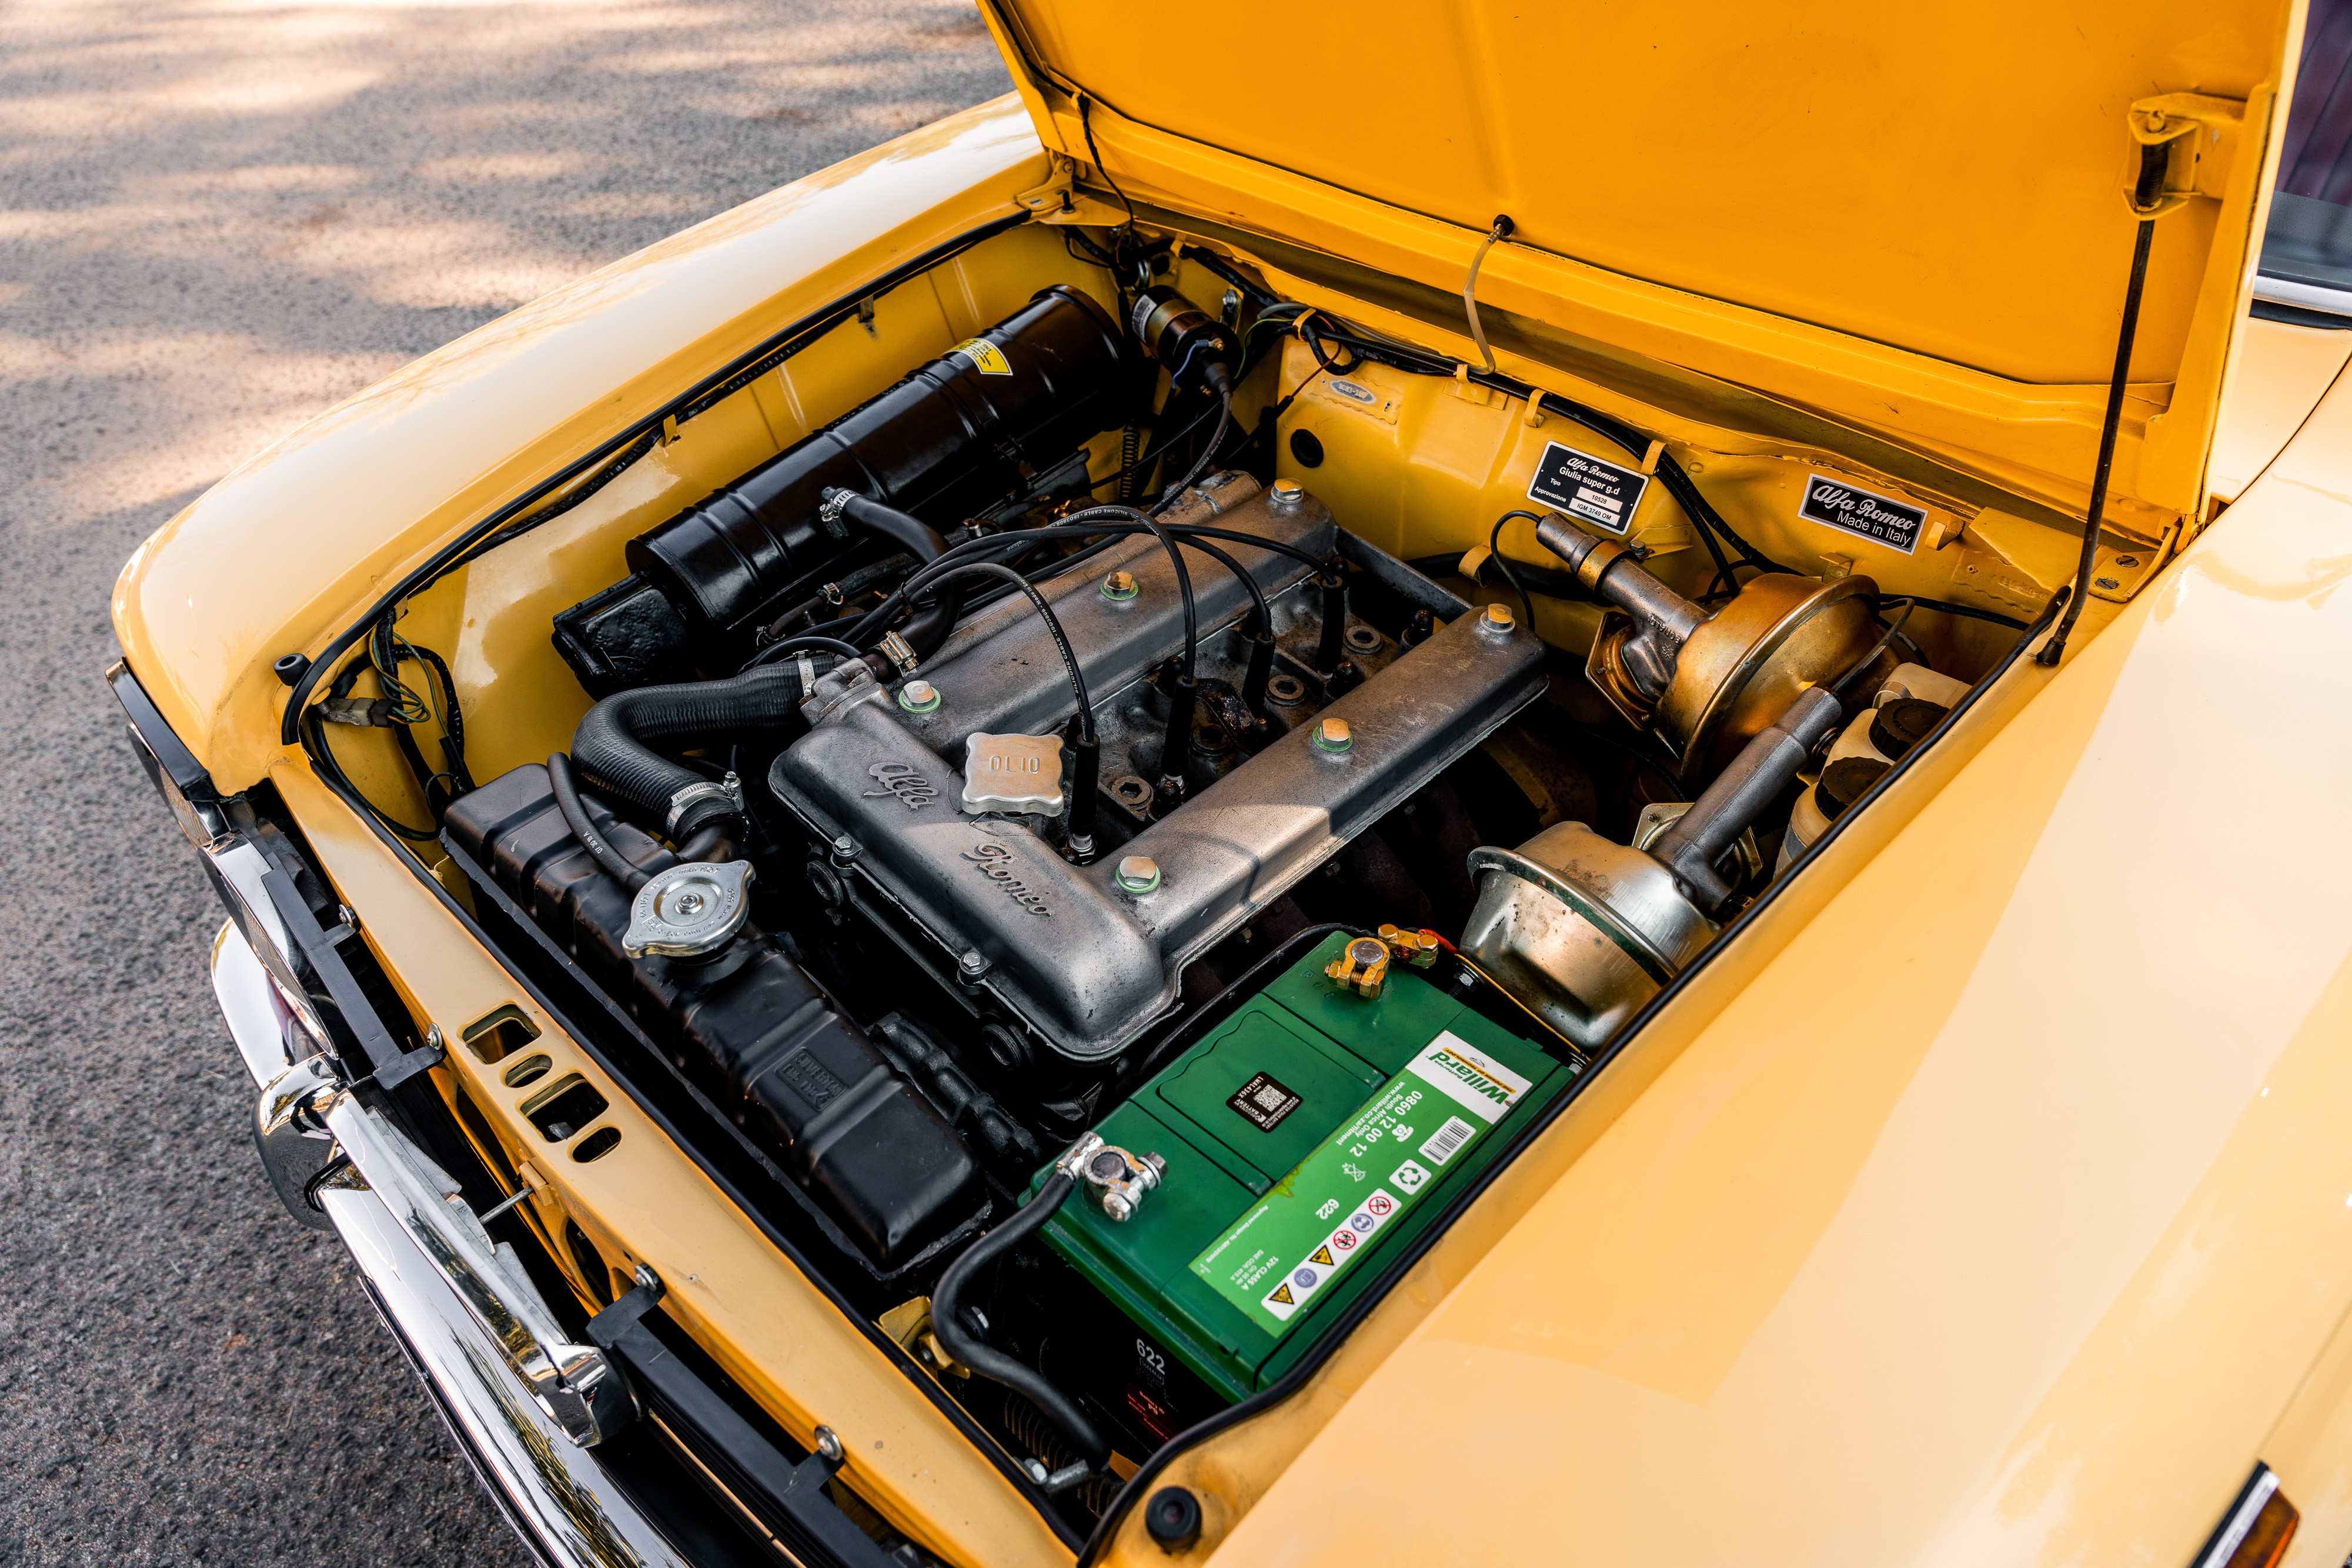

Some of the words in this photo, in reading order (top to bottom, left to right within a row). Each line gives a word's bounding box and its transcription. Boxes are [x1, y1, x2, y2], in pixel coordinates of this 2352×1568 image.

[1566, 457, 1588, 472] Alfa
[1588, 465, 1619, 482] Romeo
[1551, 478, 1561, 486] Tipo
[1559, 466, 1581, 481] Giulia
[1582, 477, 1606, 490] super
[1606, 486, 1621, 496] g.d
[1535, 486, 1566, 502] Approvazione
[1592, 494, 1608, 504] 10528
[1577, 503, 1588, 511] IGM
[1589, 506, 1601, 516] 3749
[1602, 511, 1612, 520] OM
[1812, 485, 1855, 510] Alfa
[1856, 499, 1916, 530] Romeo
[1056, 515, 1080, 526] ISO3808
[1837, 510, 1869, 530] Made
[1872, 522, 1883, 536] in
[1886, 527, 1911, 547] Italy
[1013, 573, 1028, 588] England
[1031, 591, 1041, 606] Made
[1041, 609, 1057, 633] ISO3808
[1056, 637, 1068, 660] CABLE
[1065, 661, 1079, 694] SILICONE
[988, 755, 1040, 774] OLIO
[861, 762, 938, 812] Alfa
[639, 893, 651, 908] NOT
[677, 867, 697, 875] WHEN
[700, 865, 720, 875] HOT
[958, 843, 1052, 918] Romeo
[657, 929, 680, 938] CHECK
[1445, 1049, 1477, 1069] TECHNOLOGY
[1428, 1052, 1509, 1105] Willard
[1434, 1060, 1463, 1079] Batteries
[1238, 1076, 1264, 1098] LWAL436X
[1485, 1074, 1502, 1086] POWER
[1237, 1098, 1259, 1115] BATTERY
[1284, 1099, 1299, 1112] REGISTER
[1384, 1094, 1403, 1110] South
[1394, 1091, 1422, 1115] 0860
[1265, 1117, 1278, 1129] BATTERY
[1276, 1109, 1286, 1118] YOUR
[1336, 1082, 1405, 1145] www.willard.co.za/fitment
[1368, 1108, 1387, 1125] Africa
[1379, 1115, 1396, 1129] 12
[1353, 1124, 1371, 1138] Only
[1365, 1128, 1383, 1143] 00
[1349, 1143, 1367, 1157] 12
[1248, 1205, 1269, 1225] Registered
[1315, 1199, 1339, 1219] 622
[1265, 1256, 1279, 1269] 12V
[1247, 1266, 1268, 1286] CLASS
[1136, 1338, 1165, 1375] 622
